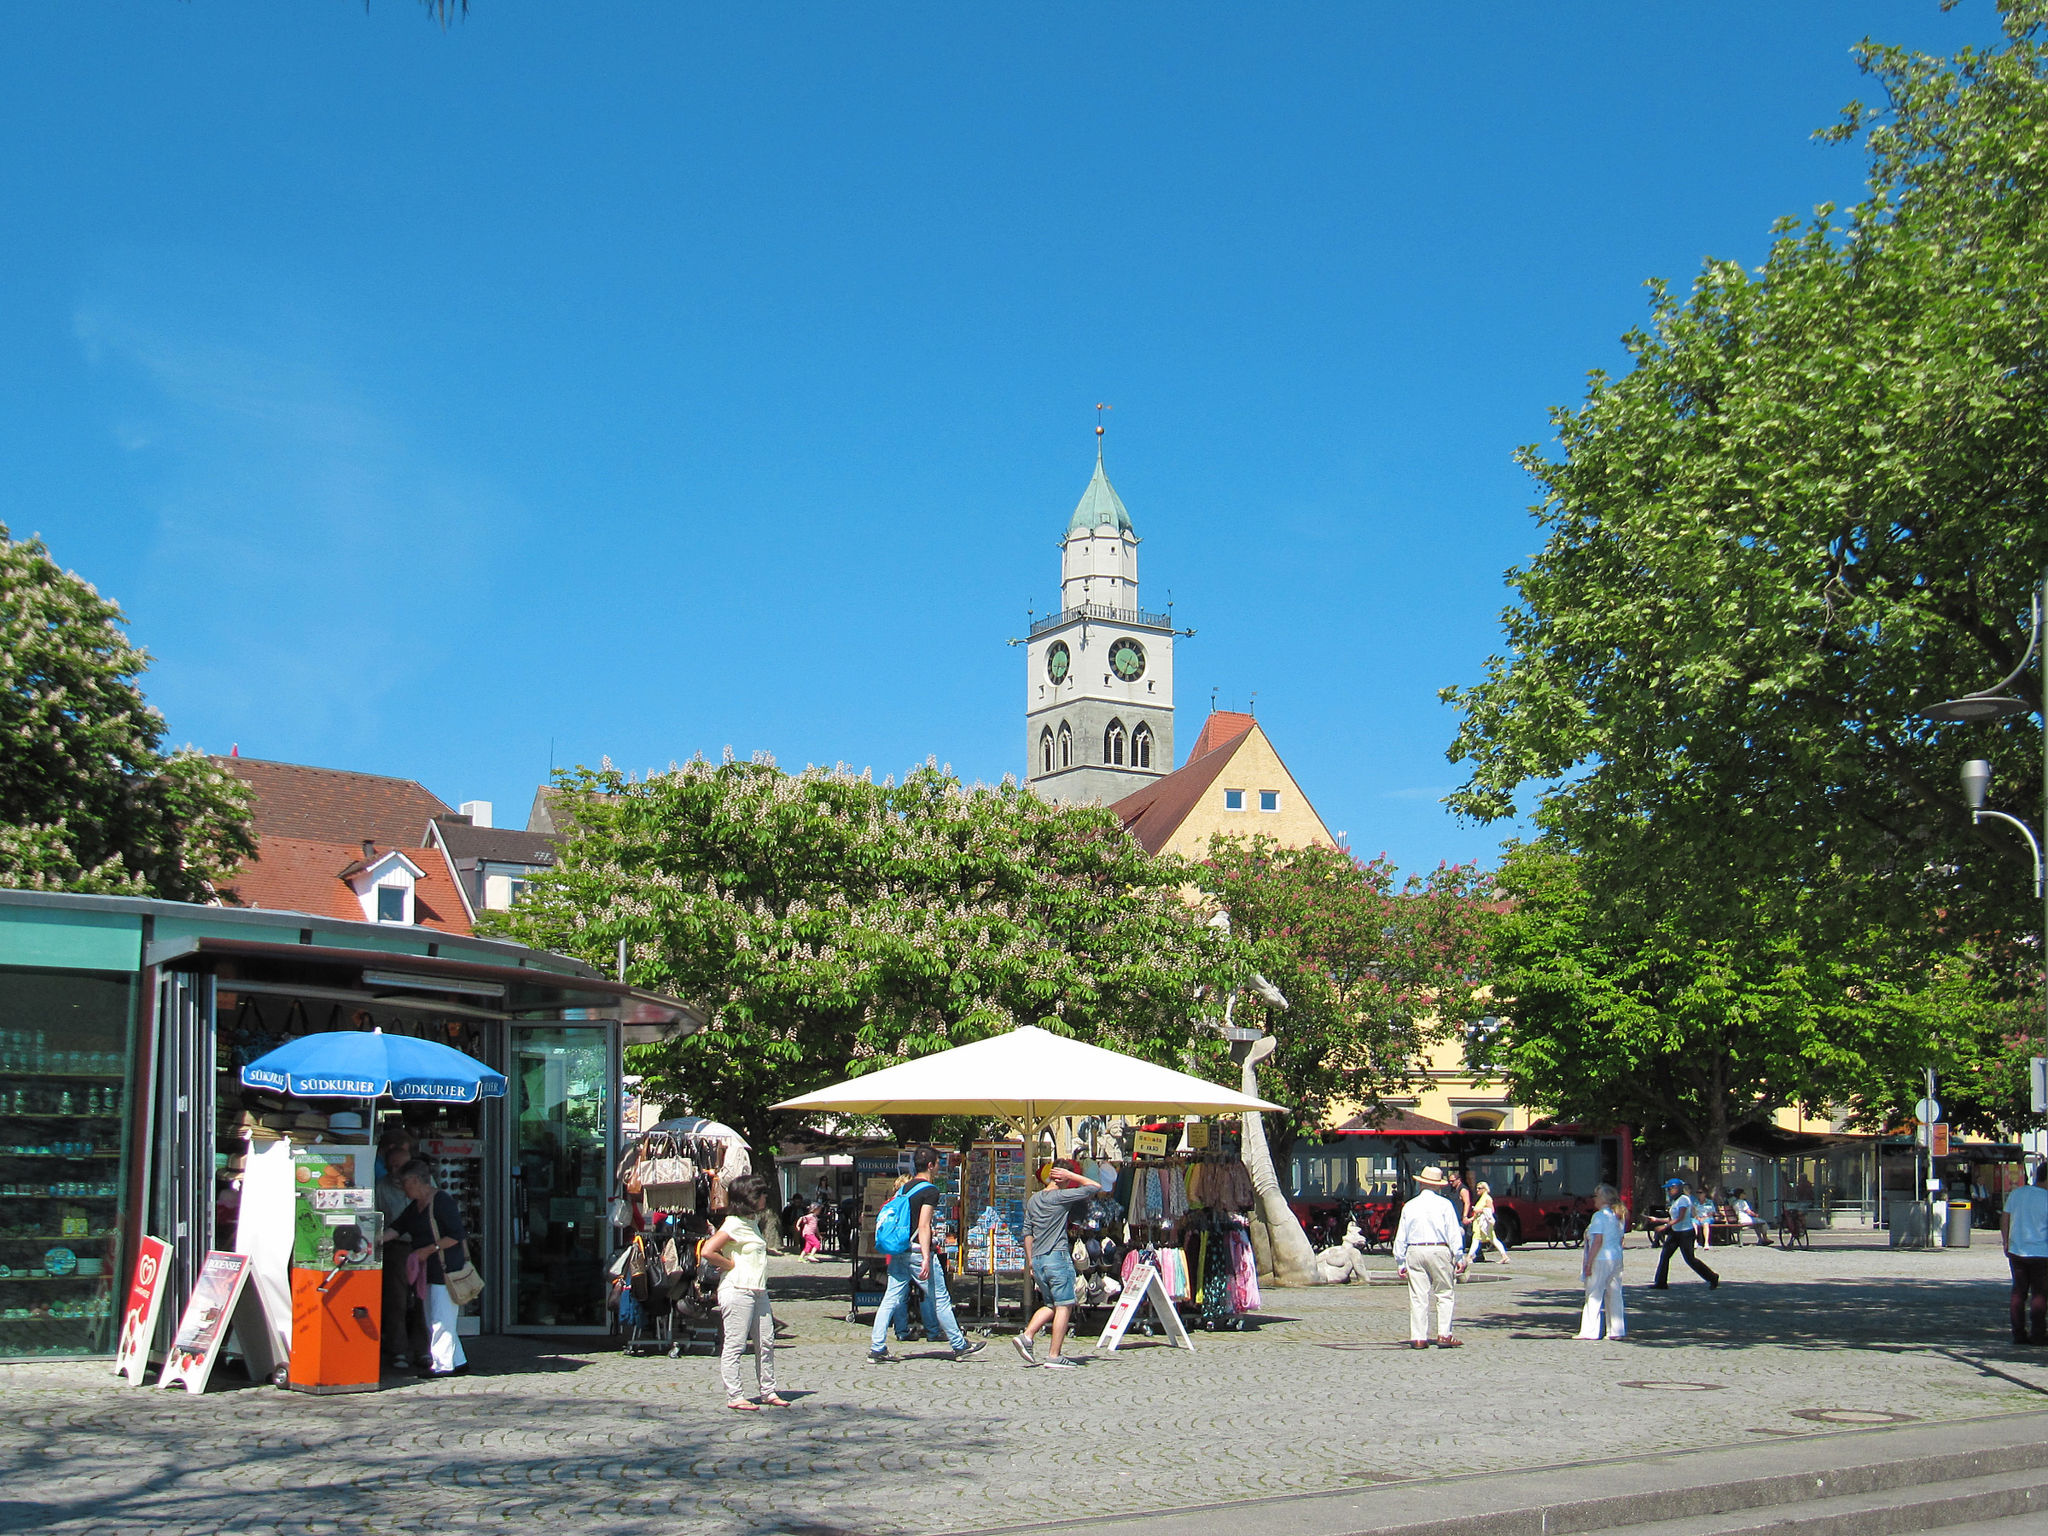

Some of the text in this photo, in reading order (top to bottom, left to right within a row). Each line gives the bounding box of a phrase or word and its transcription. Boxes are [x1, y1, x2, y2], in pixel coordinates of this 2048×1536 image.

[300, 1078, 375, 1093] SÜDKURIER
[399, 1083, 466, 1097] SÜDKURIER
[1489, 1138, 1514, 1149] Regio
